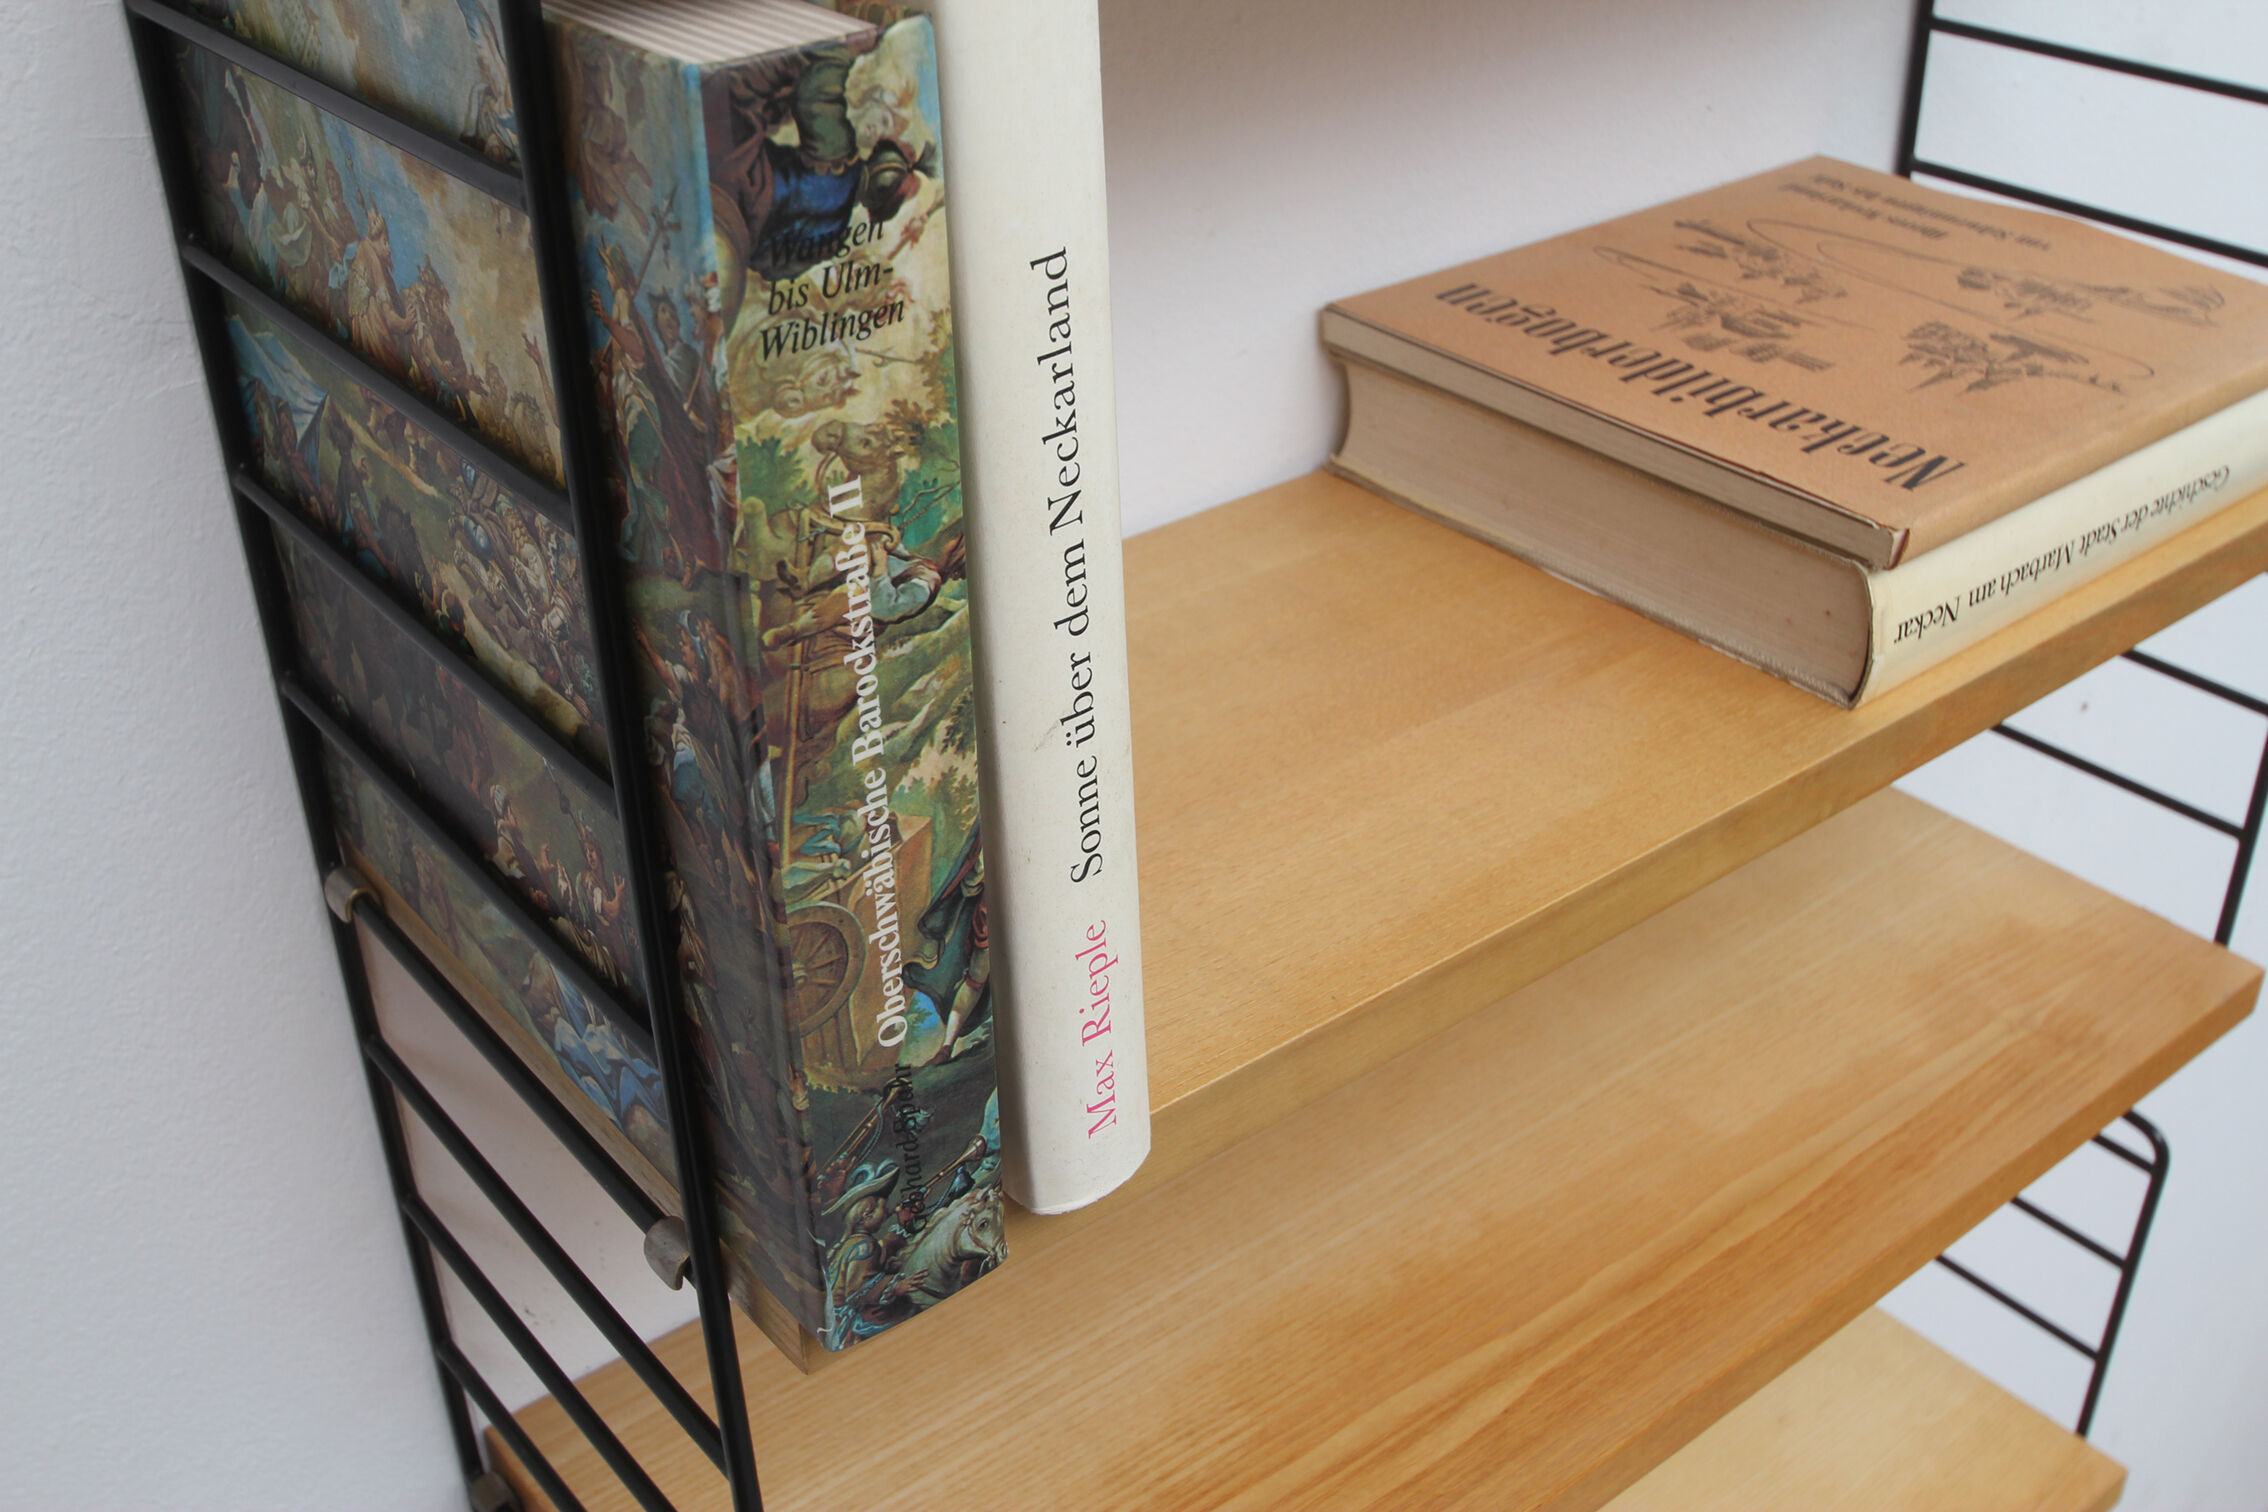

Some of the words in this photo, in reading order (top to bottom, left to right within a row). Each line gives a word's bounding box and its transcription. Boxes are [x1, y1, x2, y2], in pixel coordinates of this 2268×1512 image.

[760, 299, 905, 362] Wiblingen
[767, 280, 808, 315] bis
[821, 261, 894, 299] Ulm-
[1030, 246, 1084, 537] Neckarland
[1434, 282, 1966, 492] Neckarbilderbogen
[827, 475, 864, 519] II
[2120, 501, 2151, 532] der
[2151, 464, 2231, 515] Geschichte
[2000, 539, 2075, 597] Marbach
[2079, 525, 2120, 557] Stadt
[1053, 538, 1089, 636] dem
[1893, 595, 1961, 644] Neckar
[1968, 585, 1997, 608] am
[834, 521, 886, 766] Barockstraße
[1060, 651, 1097, 748] über
[1069, 754, 1104, 884] Sonne
[857, 767, 908, 1049] Oberschwäbische
[1075, 918, 1119, 1049] Rieple
[1087, 1049, 1118, 1139] Max
[895, 1137, 928, 1235] Gebhard
